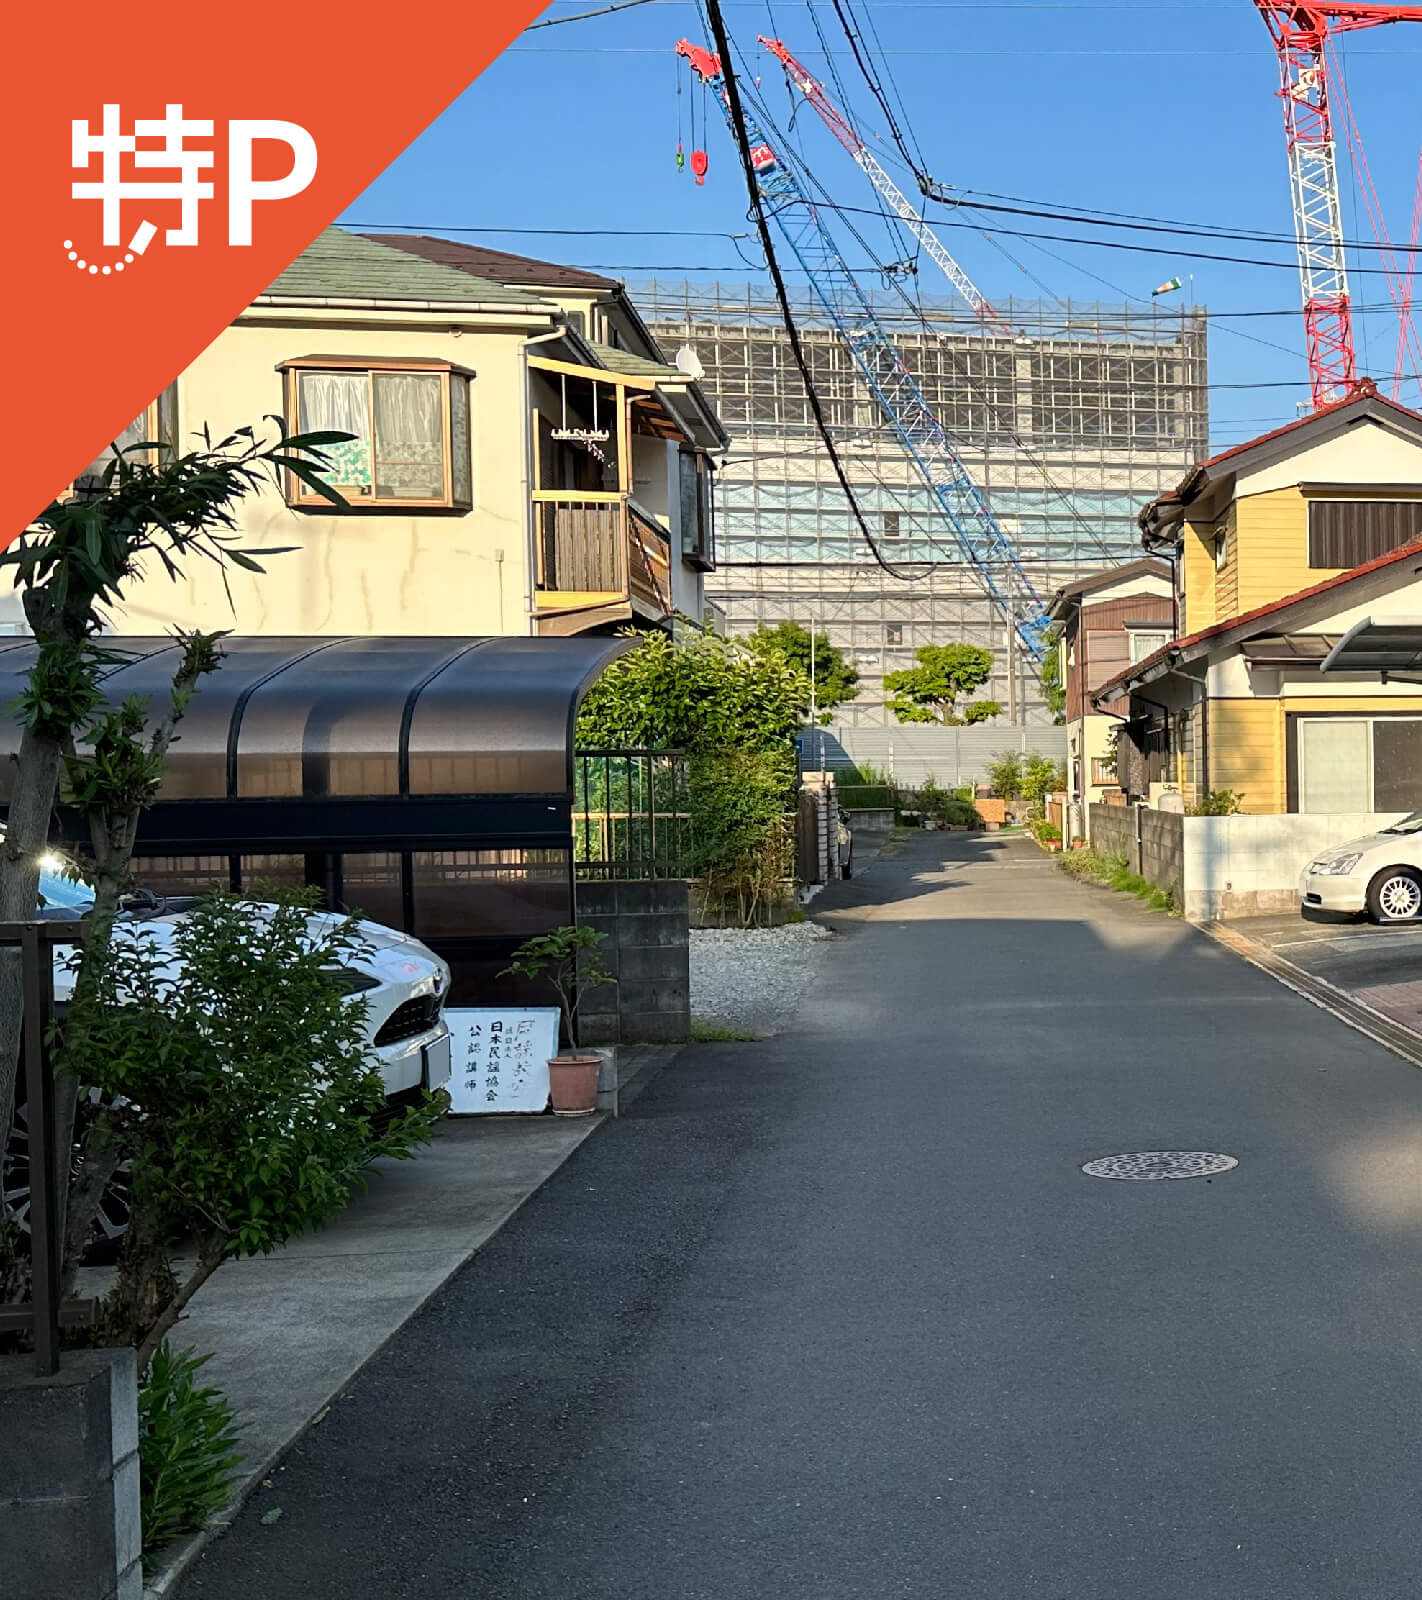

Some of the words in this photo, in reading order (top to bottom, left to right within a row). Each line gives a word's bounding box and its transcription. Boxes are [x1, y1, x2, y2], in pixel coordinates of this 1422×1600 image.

[486, 1020, 503, 1102] 日本民謡協会
